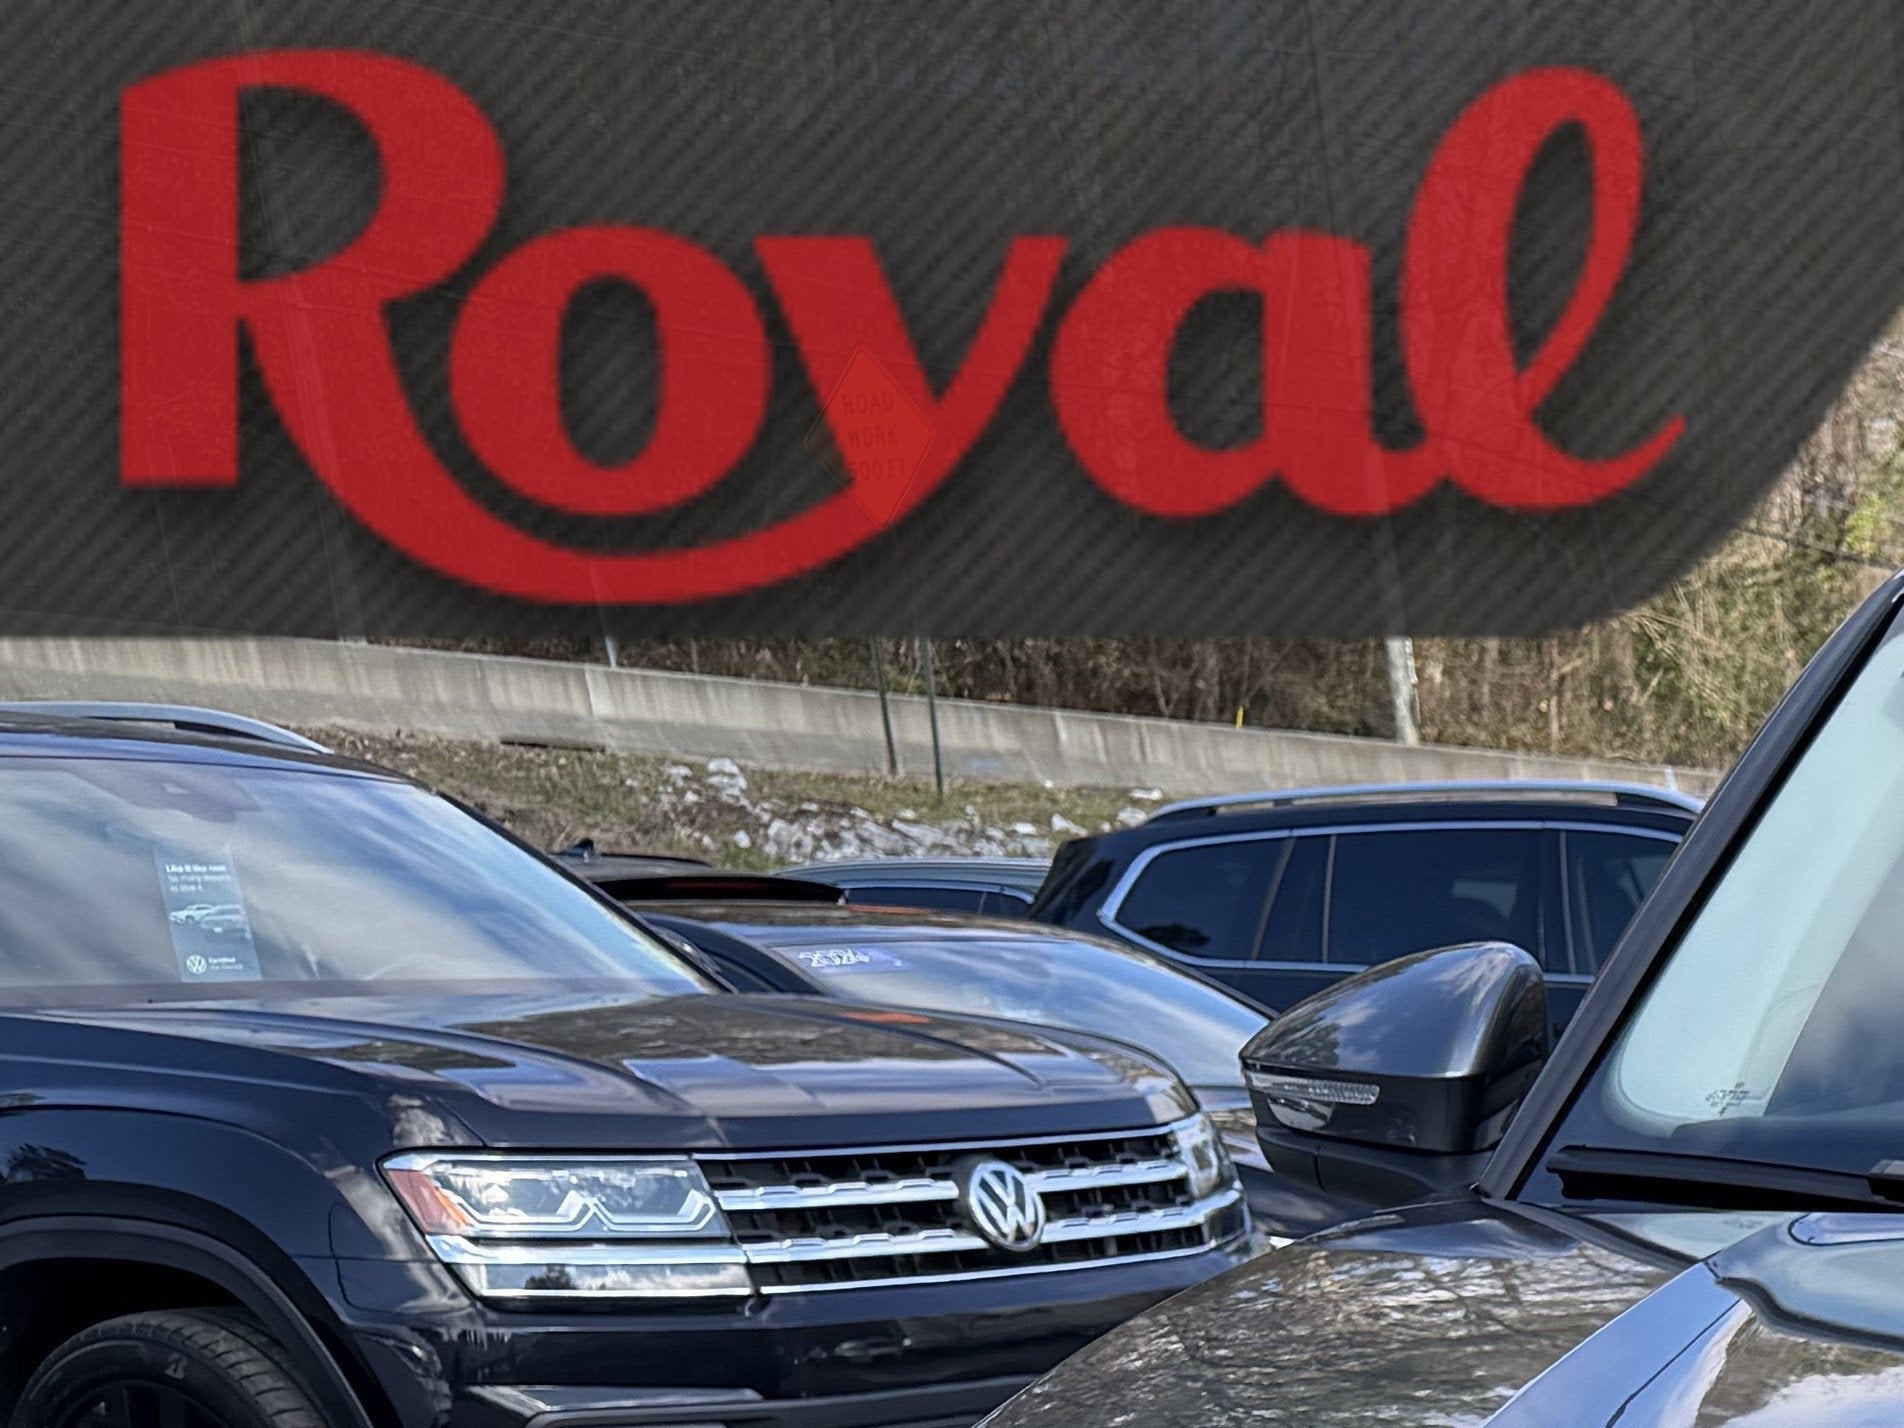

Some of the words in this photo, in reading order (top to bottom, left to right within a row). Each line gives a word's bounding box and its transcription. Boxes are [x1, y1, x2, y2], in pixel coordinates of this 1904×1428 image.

[842, 390, 895, 416] ROAD
[848, 422, 901, 449] WORK
[846, 458, 884, 483] 500
[888, 457, 907, 479] FT
